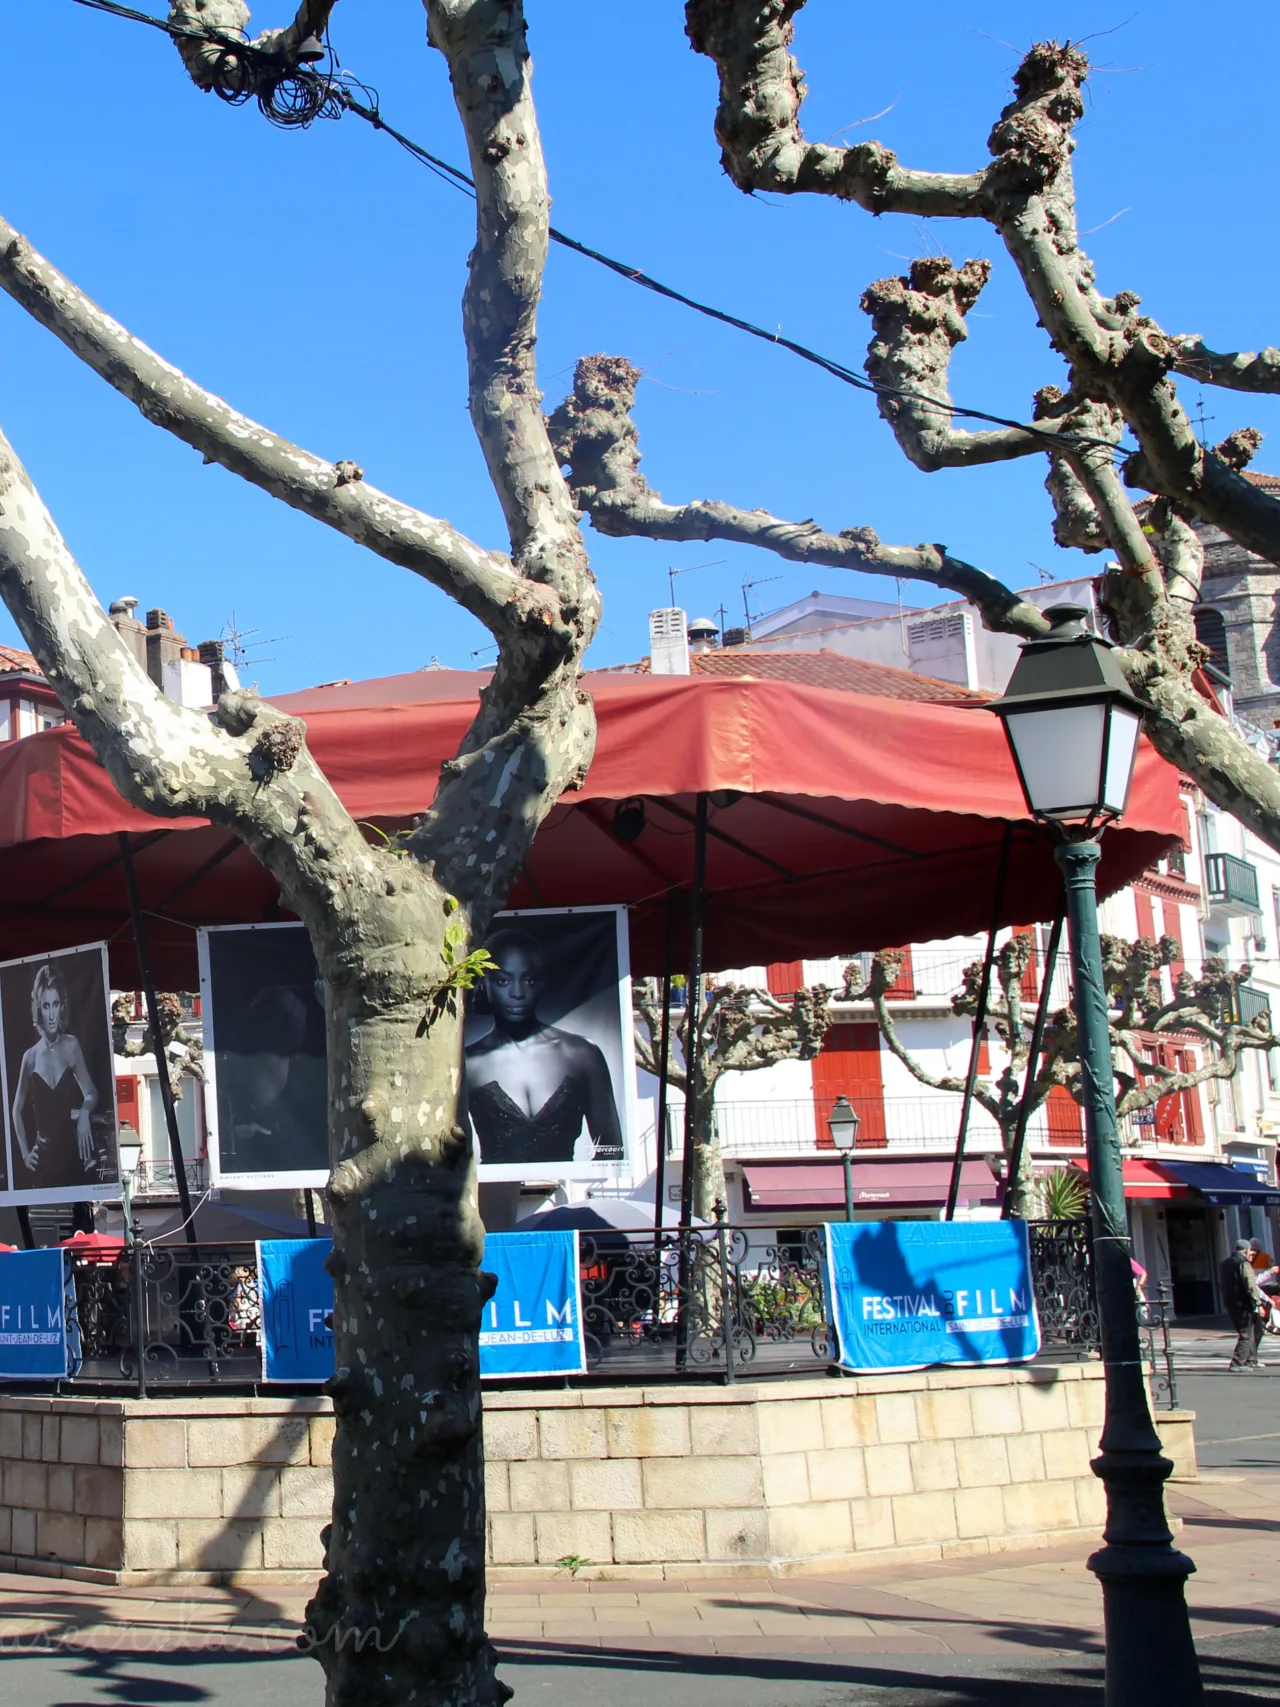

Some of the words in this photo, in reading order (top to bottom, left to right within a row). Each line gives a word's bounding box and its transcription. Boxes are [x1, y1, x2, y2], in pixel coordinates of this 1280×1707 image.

[1, 1304, 61, 1329] FILM
[490, 1297, 572, 1328] ILM
[862, 1294, 940, 1320] FESTIVAL
[944, 1290, 955, 1315] DU
[956, 1287, 1026, 1316] FILM
[863, 1320, 941, 1336] INTERNATIONAL
